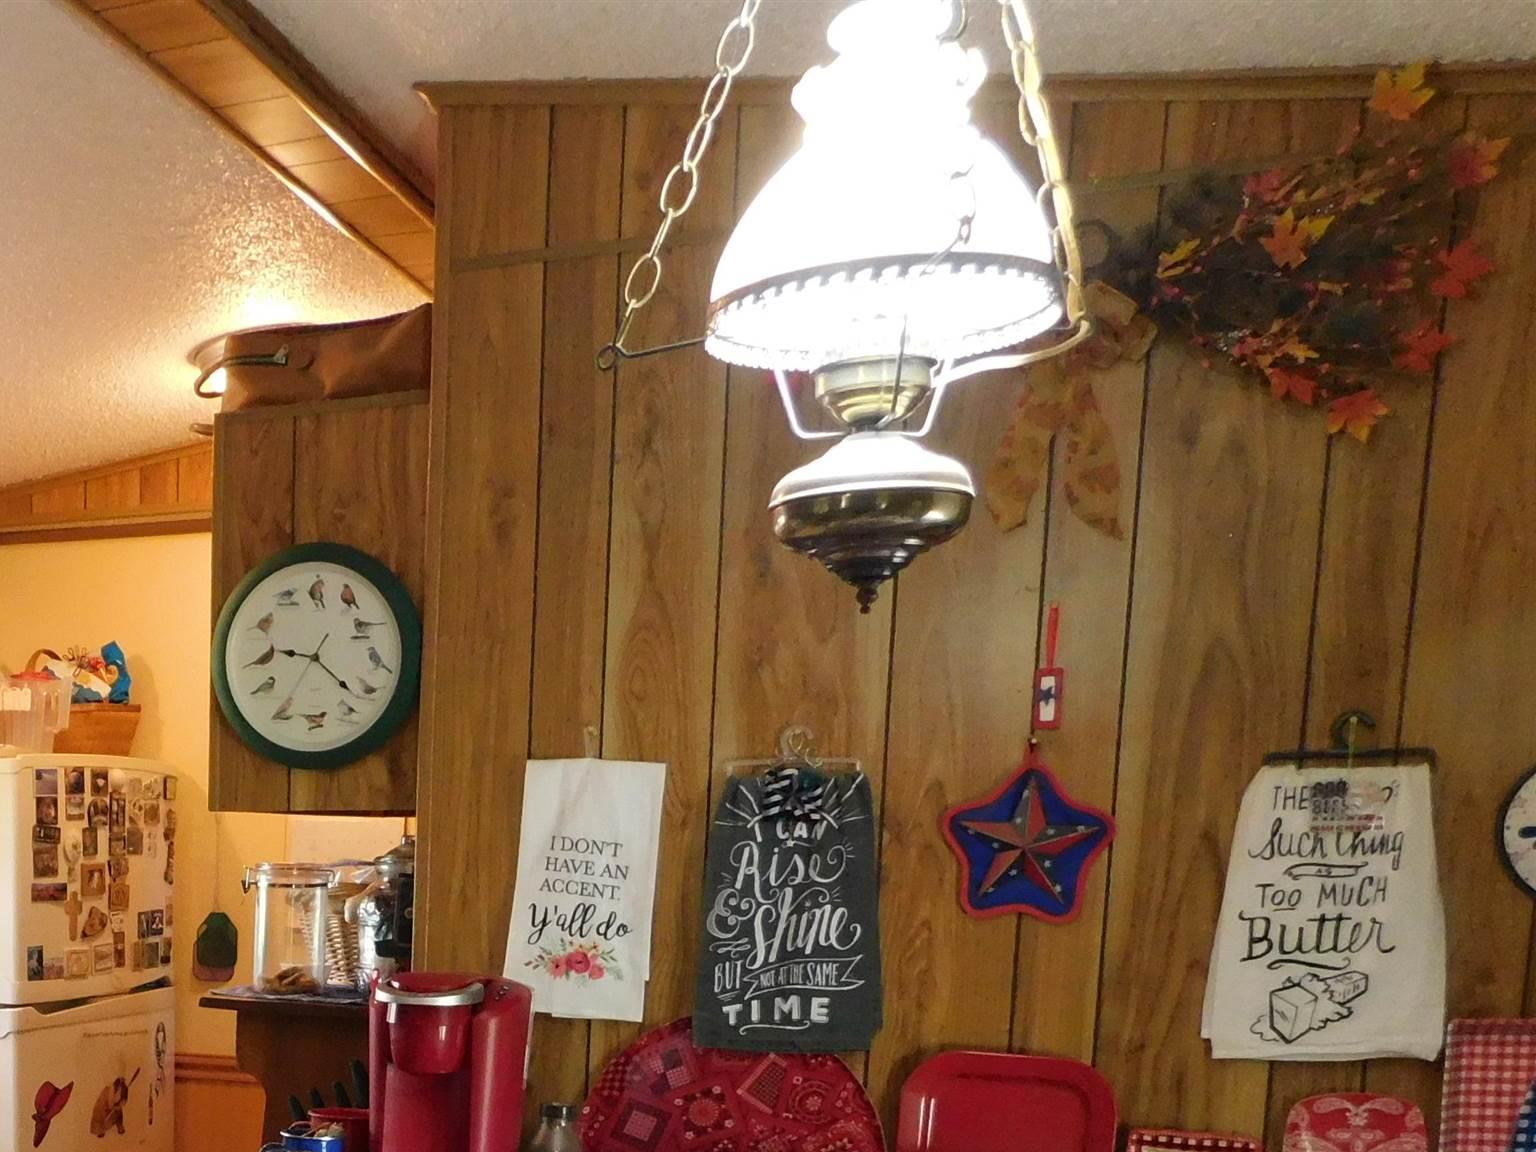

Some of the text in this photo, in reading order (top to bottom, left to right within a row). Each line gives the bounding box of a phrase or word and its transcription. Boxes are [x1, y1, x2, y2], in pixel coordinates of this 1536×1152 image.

[1273, 785, 1308, 811] THE
[549, 835, 624, 857] I DON'T
[754, 820, 828, 842] I CAN
[544, 856, 630, 880] HAVE AN
[730, 841, 848, 903] Rise
[539, 878, 621, 901] ACCENT.
[1255, 876, 1388, 909] TOO MUCH
[527, 902, 634, 945] Y'all do
[707, 886, 862, 970] & Shine
[1238, 911, 1396, 962] Butter
[714, 960, 840, 993] BUT NOT AT THE SAME
[721, 995, 831, 1026] TIME
